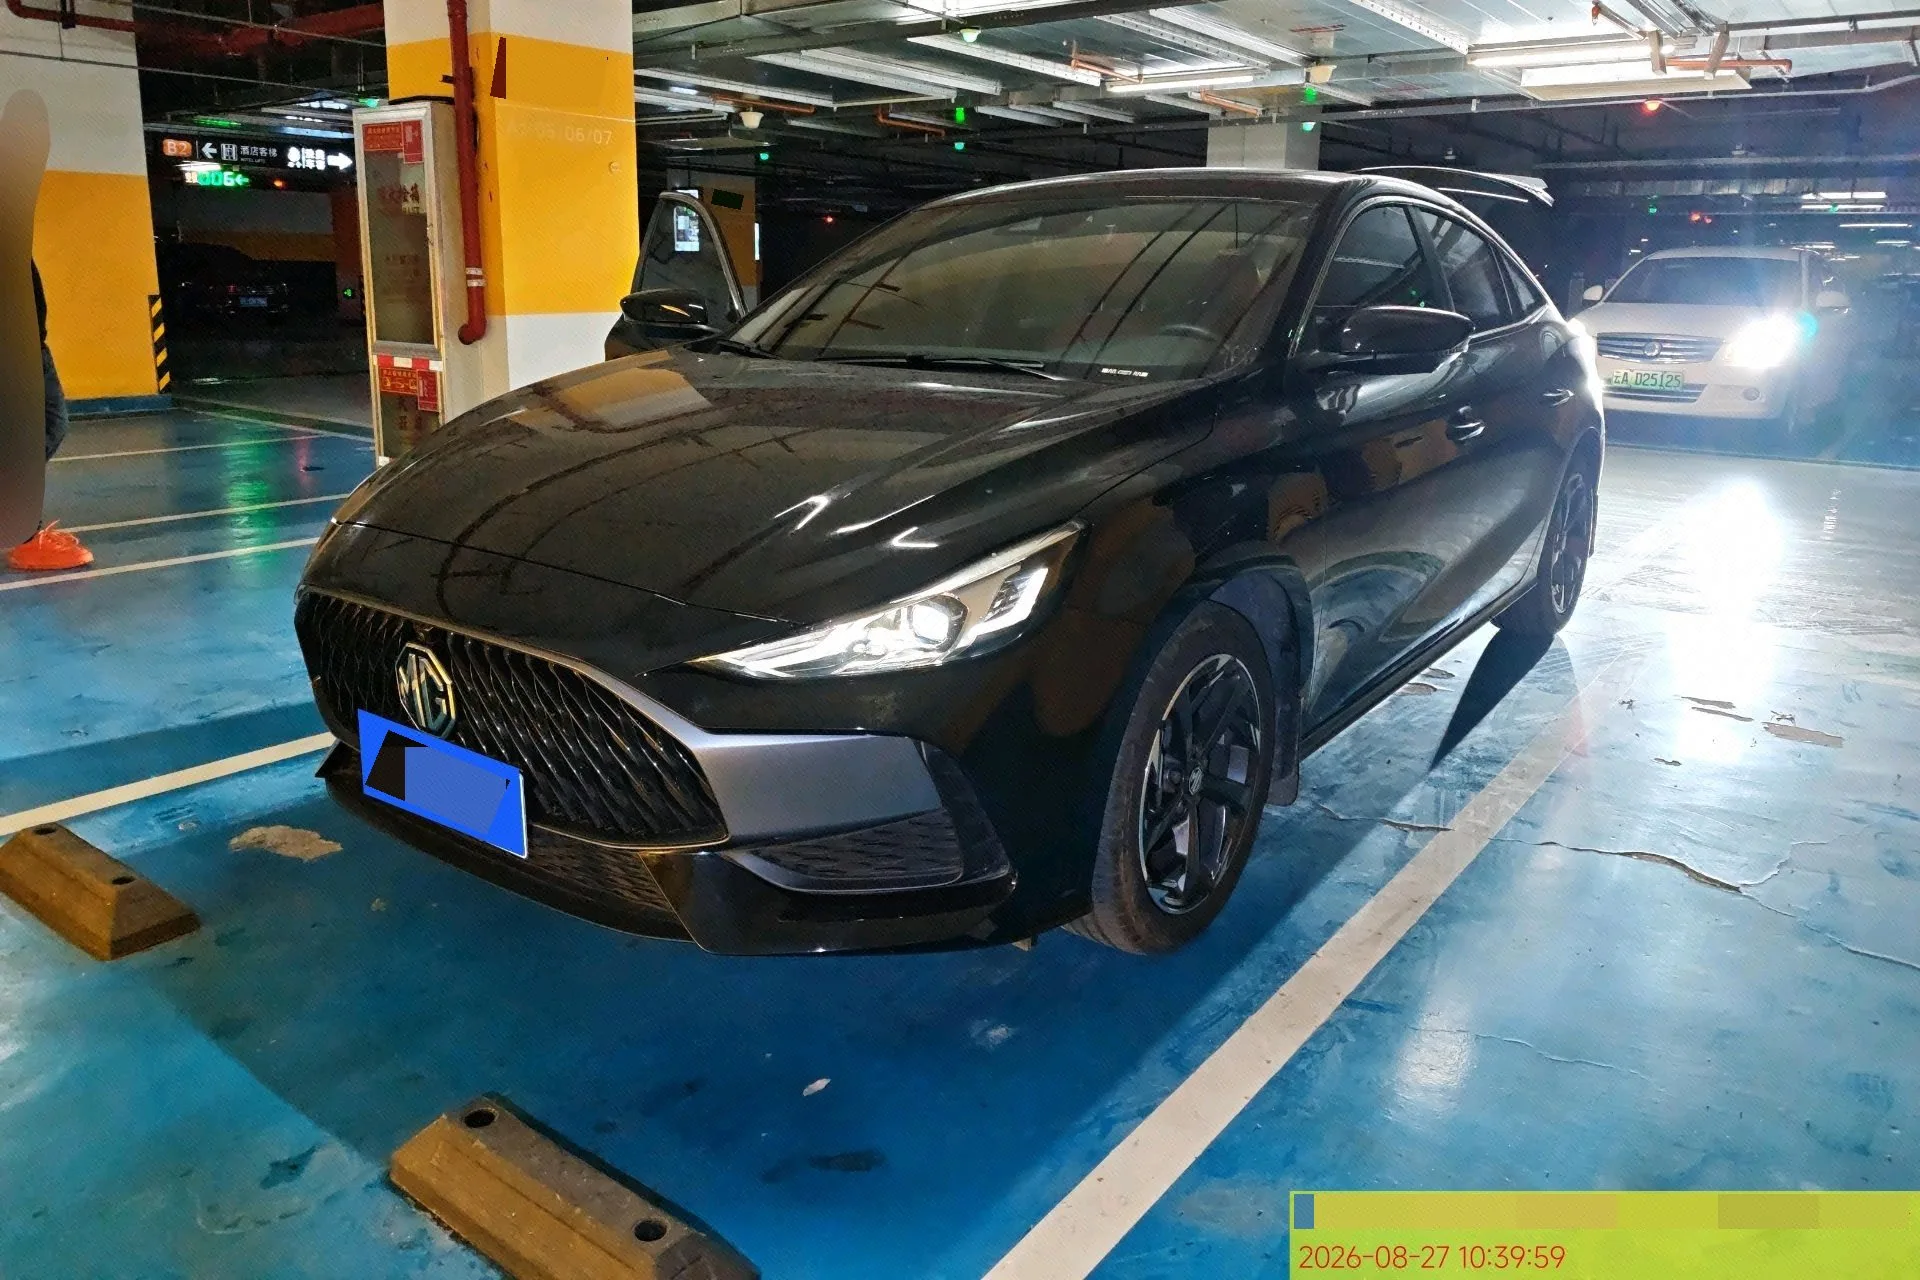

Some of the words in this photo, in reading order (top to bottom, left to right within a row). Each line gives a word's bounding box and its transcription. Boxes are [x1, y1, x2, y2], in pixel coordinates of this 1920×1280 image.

[166, 141, 187, 157] B2
[240, 145, 277, 157] 酒店客梯
[397, 650, 449, 734] MG
